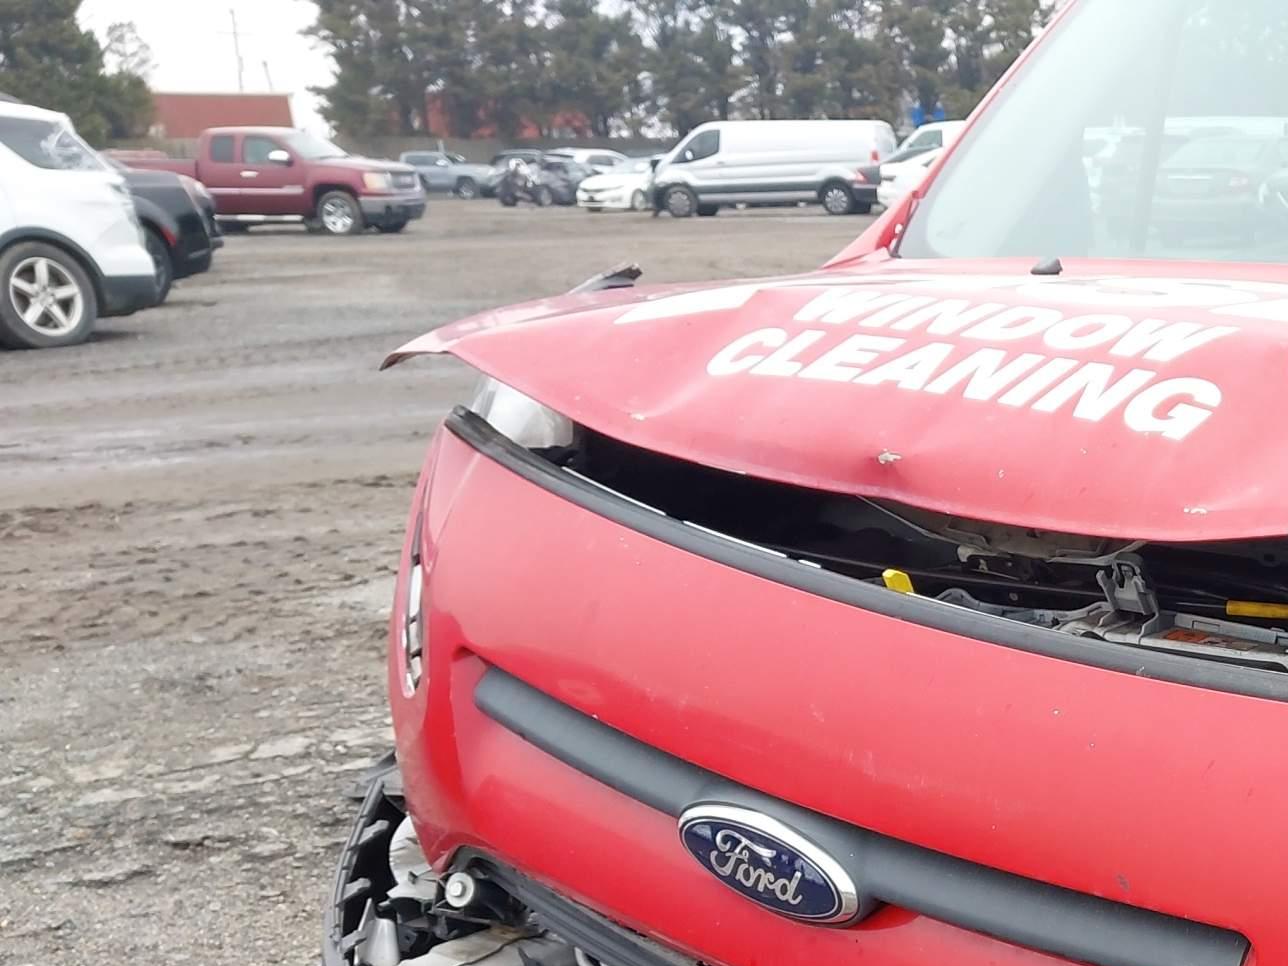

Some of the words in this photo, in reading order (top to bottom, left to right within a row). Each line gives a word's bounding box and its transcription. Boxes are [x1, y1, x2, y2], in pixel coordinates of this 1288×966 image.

[792, 288, 1241, 362] WINDOW
[706, 327, 1222, 441] CLEANING
[710, 828, 804, 905] Ford
